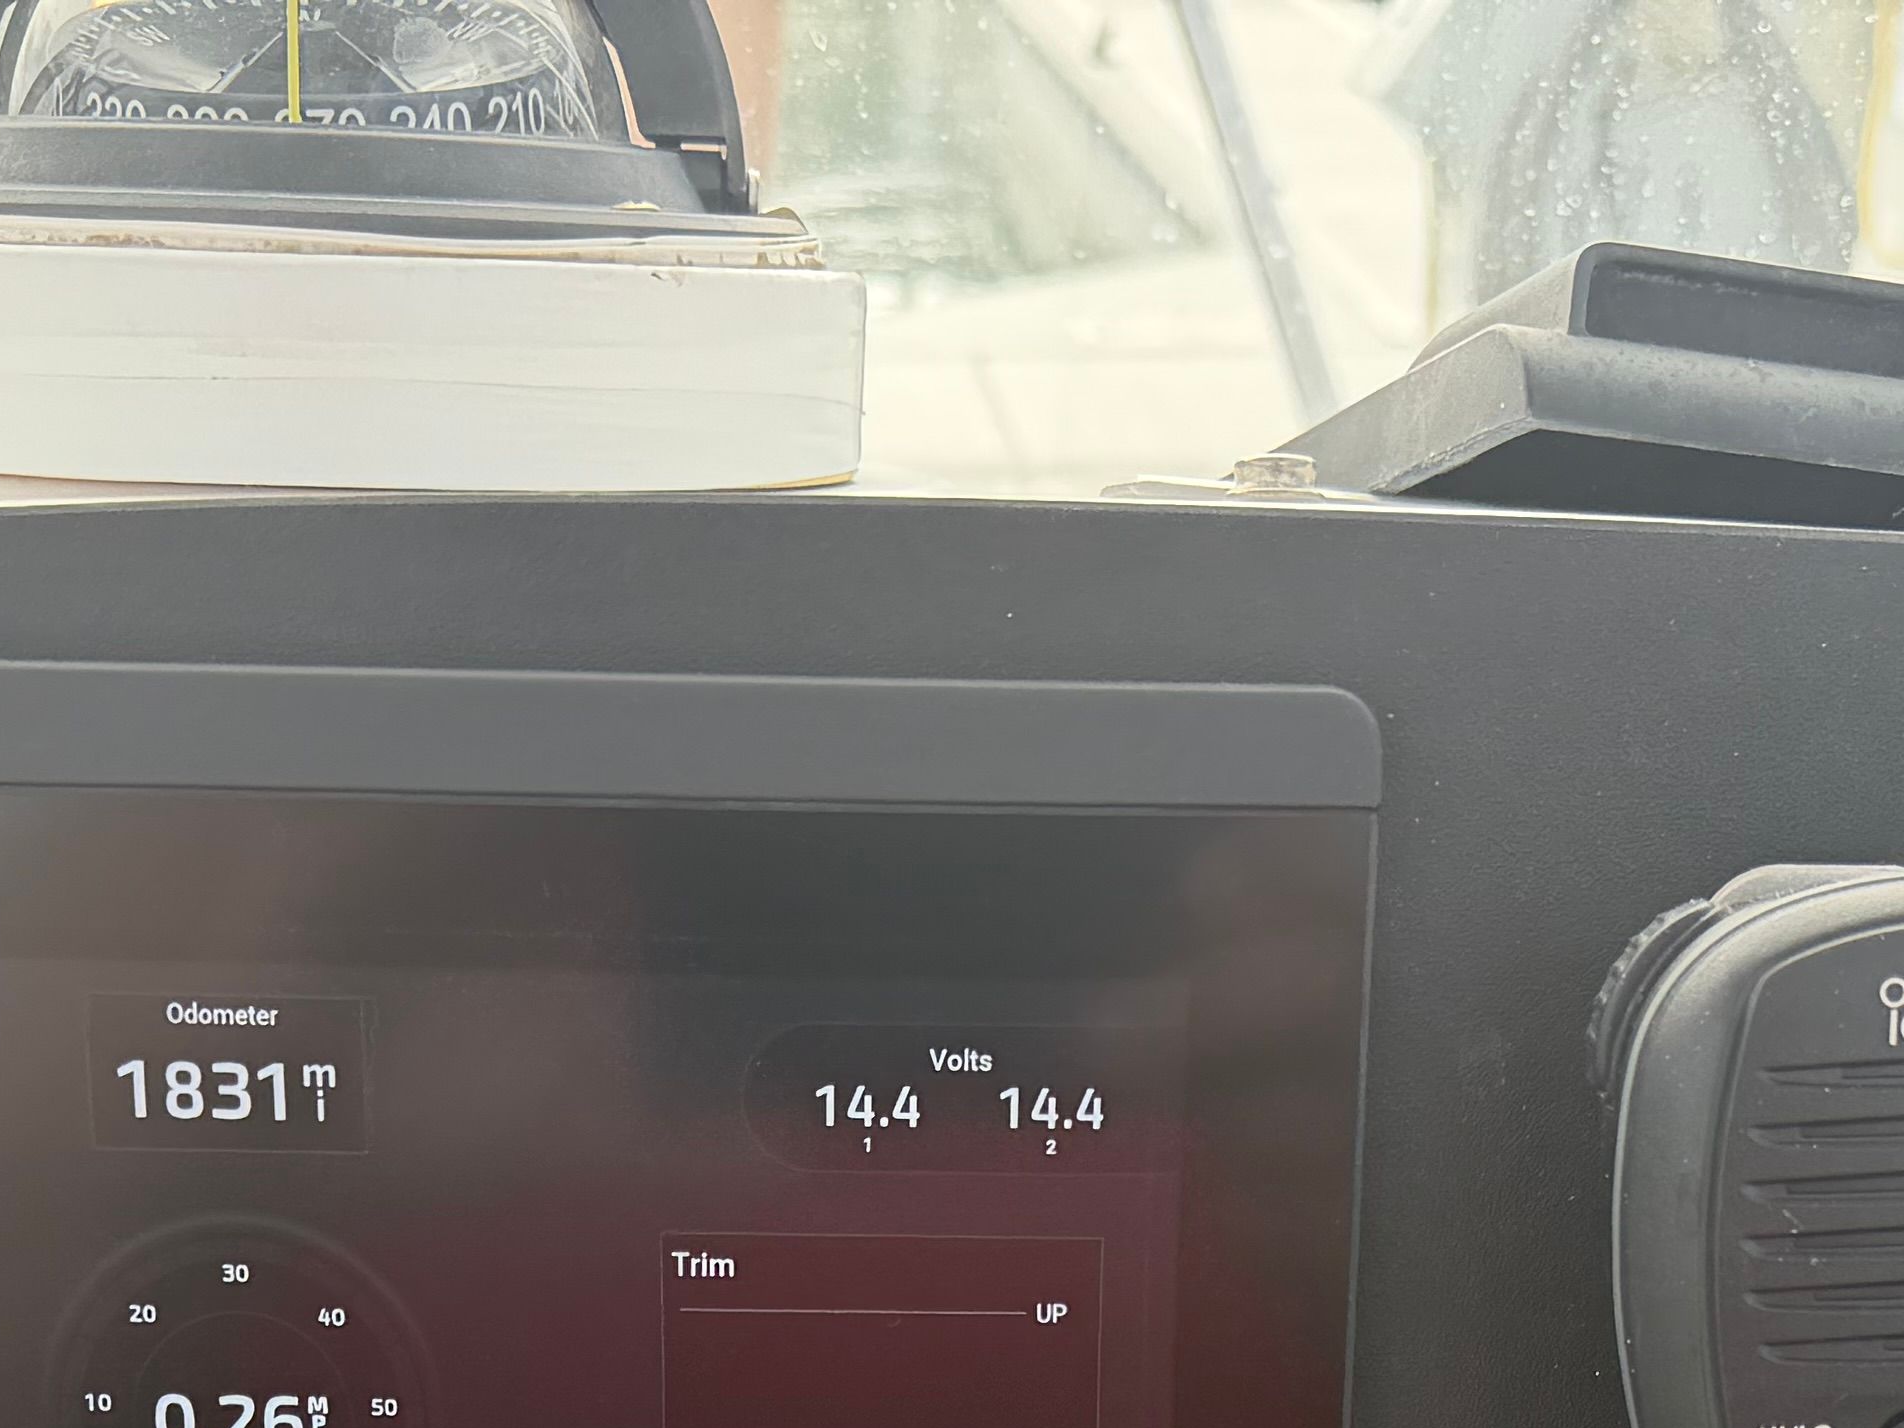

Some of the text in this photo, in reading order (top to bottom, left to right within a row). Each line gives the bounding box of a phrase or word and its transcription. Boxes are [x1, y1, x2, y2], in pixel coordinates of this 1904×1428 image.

[167, 1003, 278, 1027] Odometer
[930, 1049, 992, 1072] Volts
[117, 1060, 288, 1121] 1831
[815, 1085, 1104, 1130] 14.4 14.4
[222, 1265, 249, 1282] 30
[672, 1252, 735, 1278] Trim
[130, 1305, 156, 1324] 20
[318, 1309, 345, 1326] 40
[1036, 1304, 1067, 1324] UP
[85, 1394, 111, 1412] 10
[371, 1399, 397, 1417] 50
